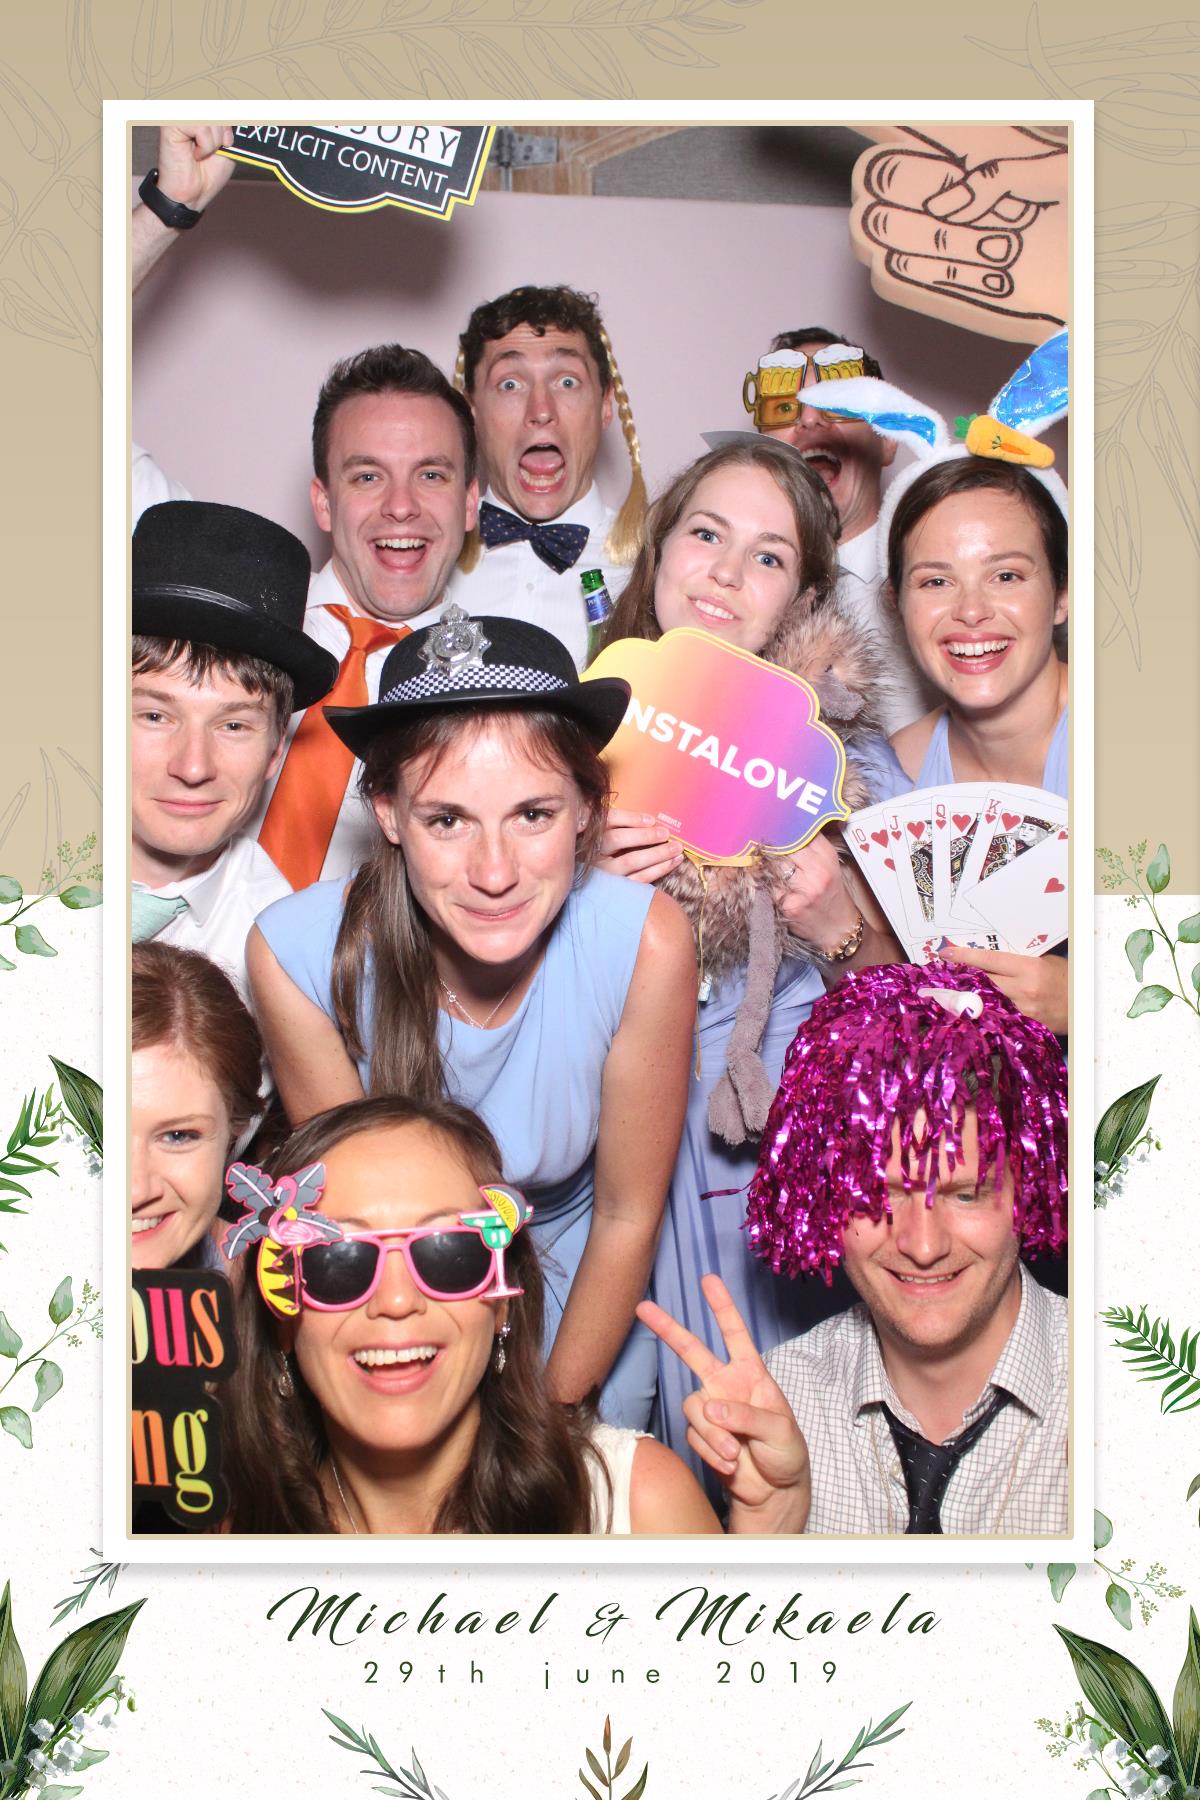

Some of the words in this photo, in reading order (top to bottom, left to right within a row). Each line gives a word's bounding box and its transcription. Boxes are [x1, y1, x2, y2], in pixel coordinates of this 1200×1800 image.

[235, 126, 336, 161] EXPLICIT
[337, 146, 449, 194] CONTENT
[620, 696, 828, 816] NSTALOVE
[936, 804, 946, 819] Q
[987, 799, 1002, 815] K
[889, 815, 899, 831] J
[852, 828, 867, 843] 10
